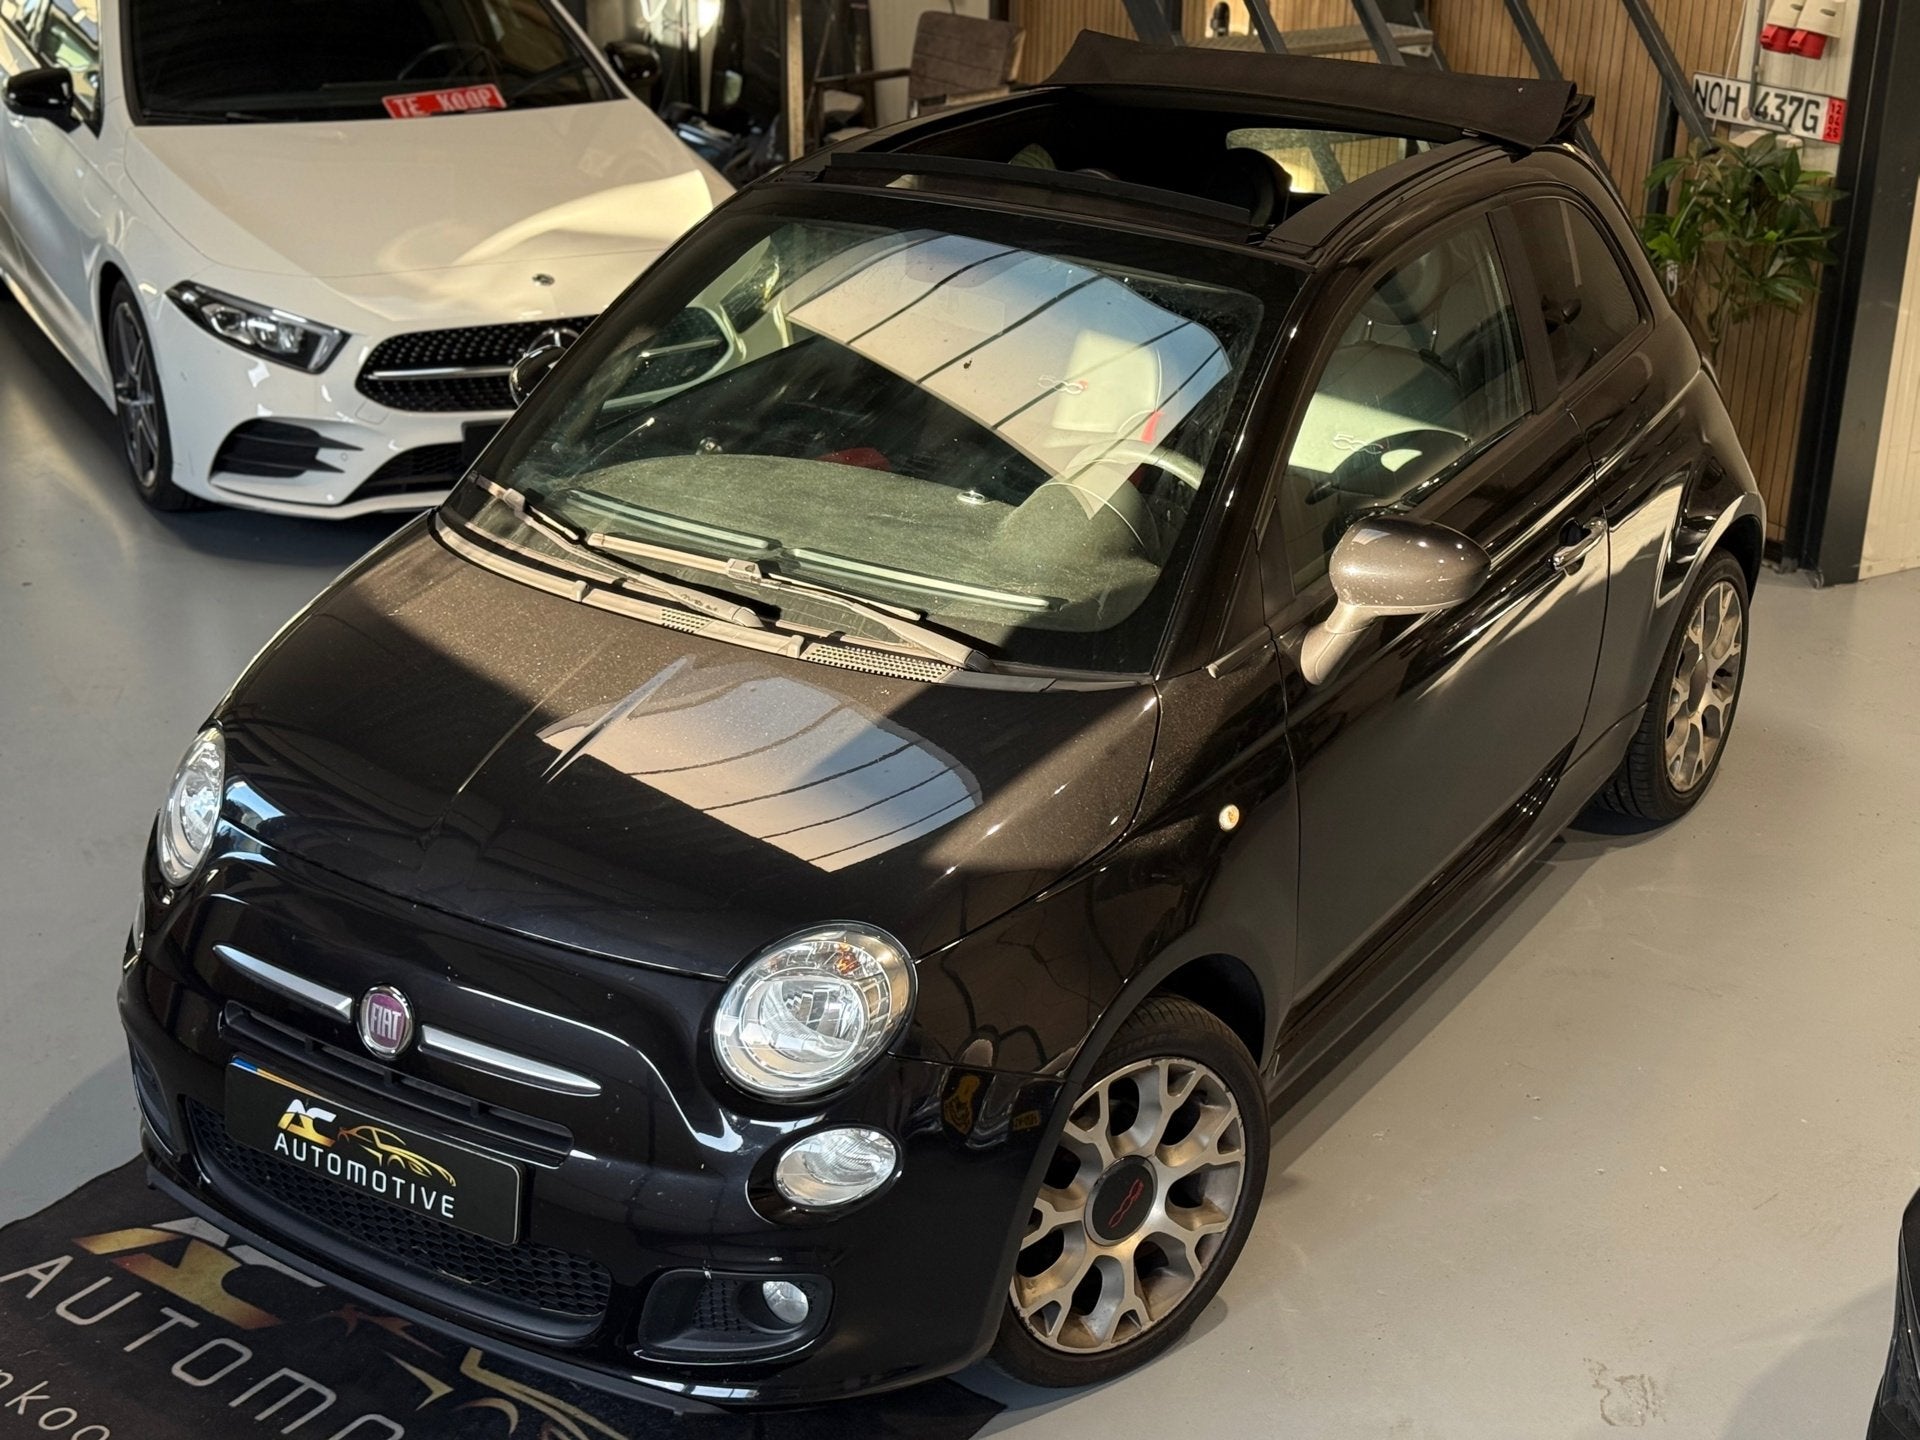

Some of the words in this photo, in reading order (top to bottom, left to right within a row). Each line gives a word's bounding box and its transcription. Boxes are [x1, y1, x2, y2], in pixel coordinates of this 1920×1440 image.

[391, 97, 431, 117] TE
[436, 88, 493, 112] KOOP
[1694, 78, 1741, 118] NOH
[1755, 91, 1820, 134] 437G
[1830, 102, 1842, 115] 12
[1825, 126, 1839, 138] 25
[1332, 433, 1384, 455] 500
[370, 1002, 402, 1041] FIAT
[277, 1099, 337, 1148] AC
[274, 1132, 456, 1219] AUTOMOTIVE
